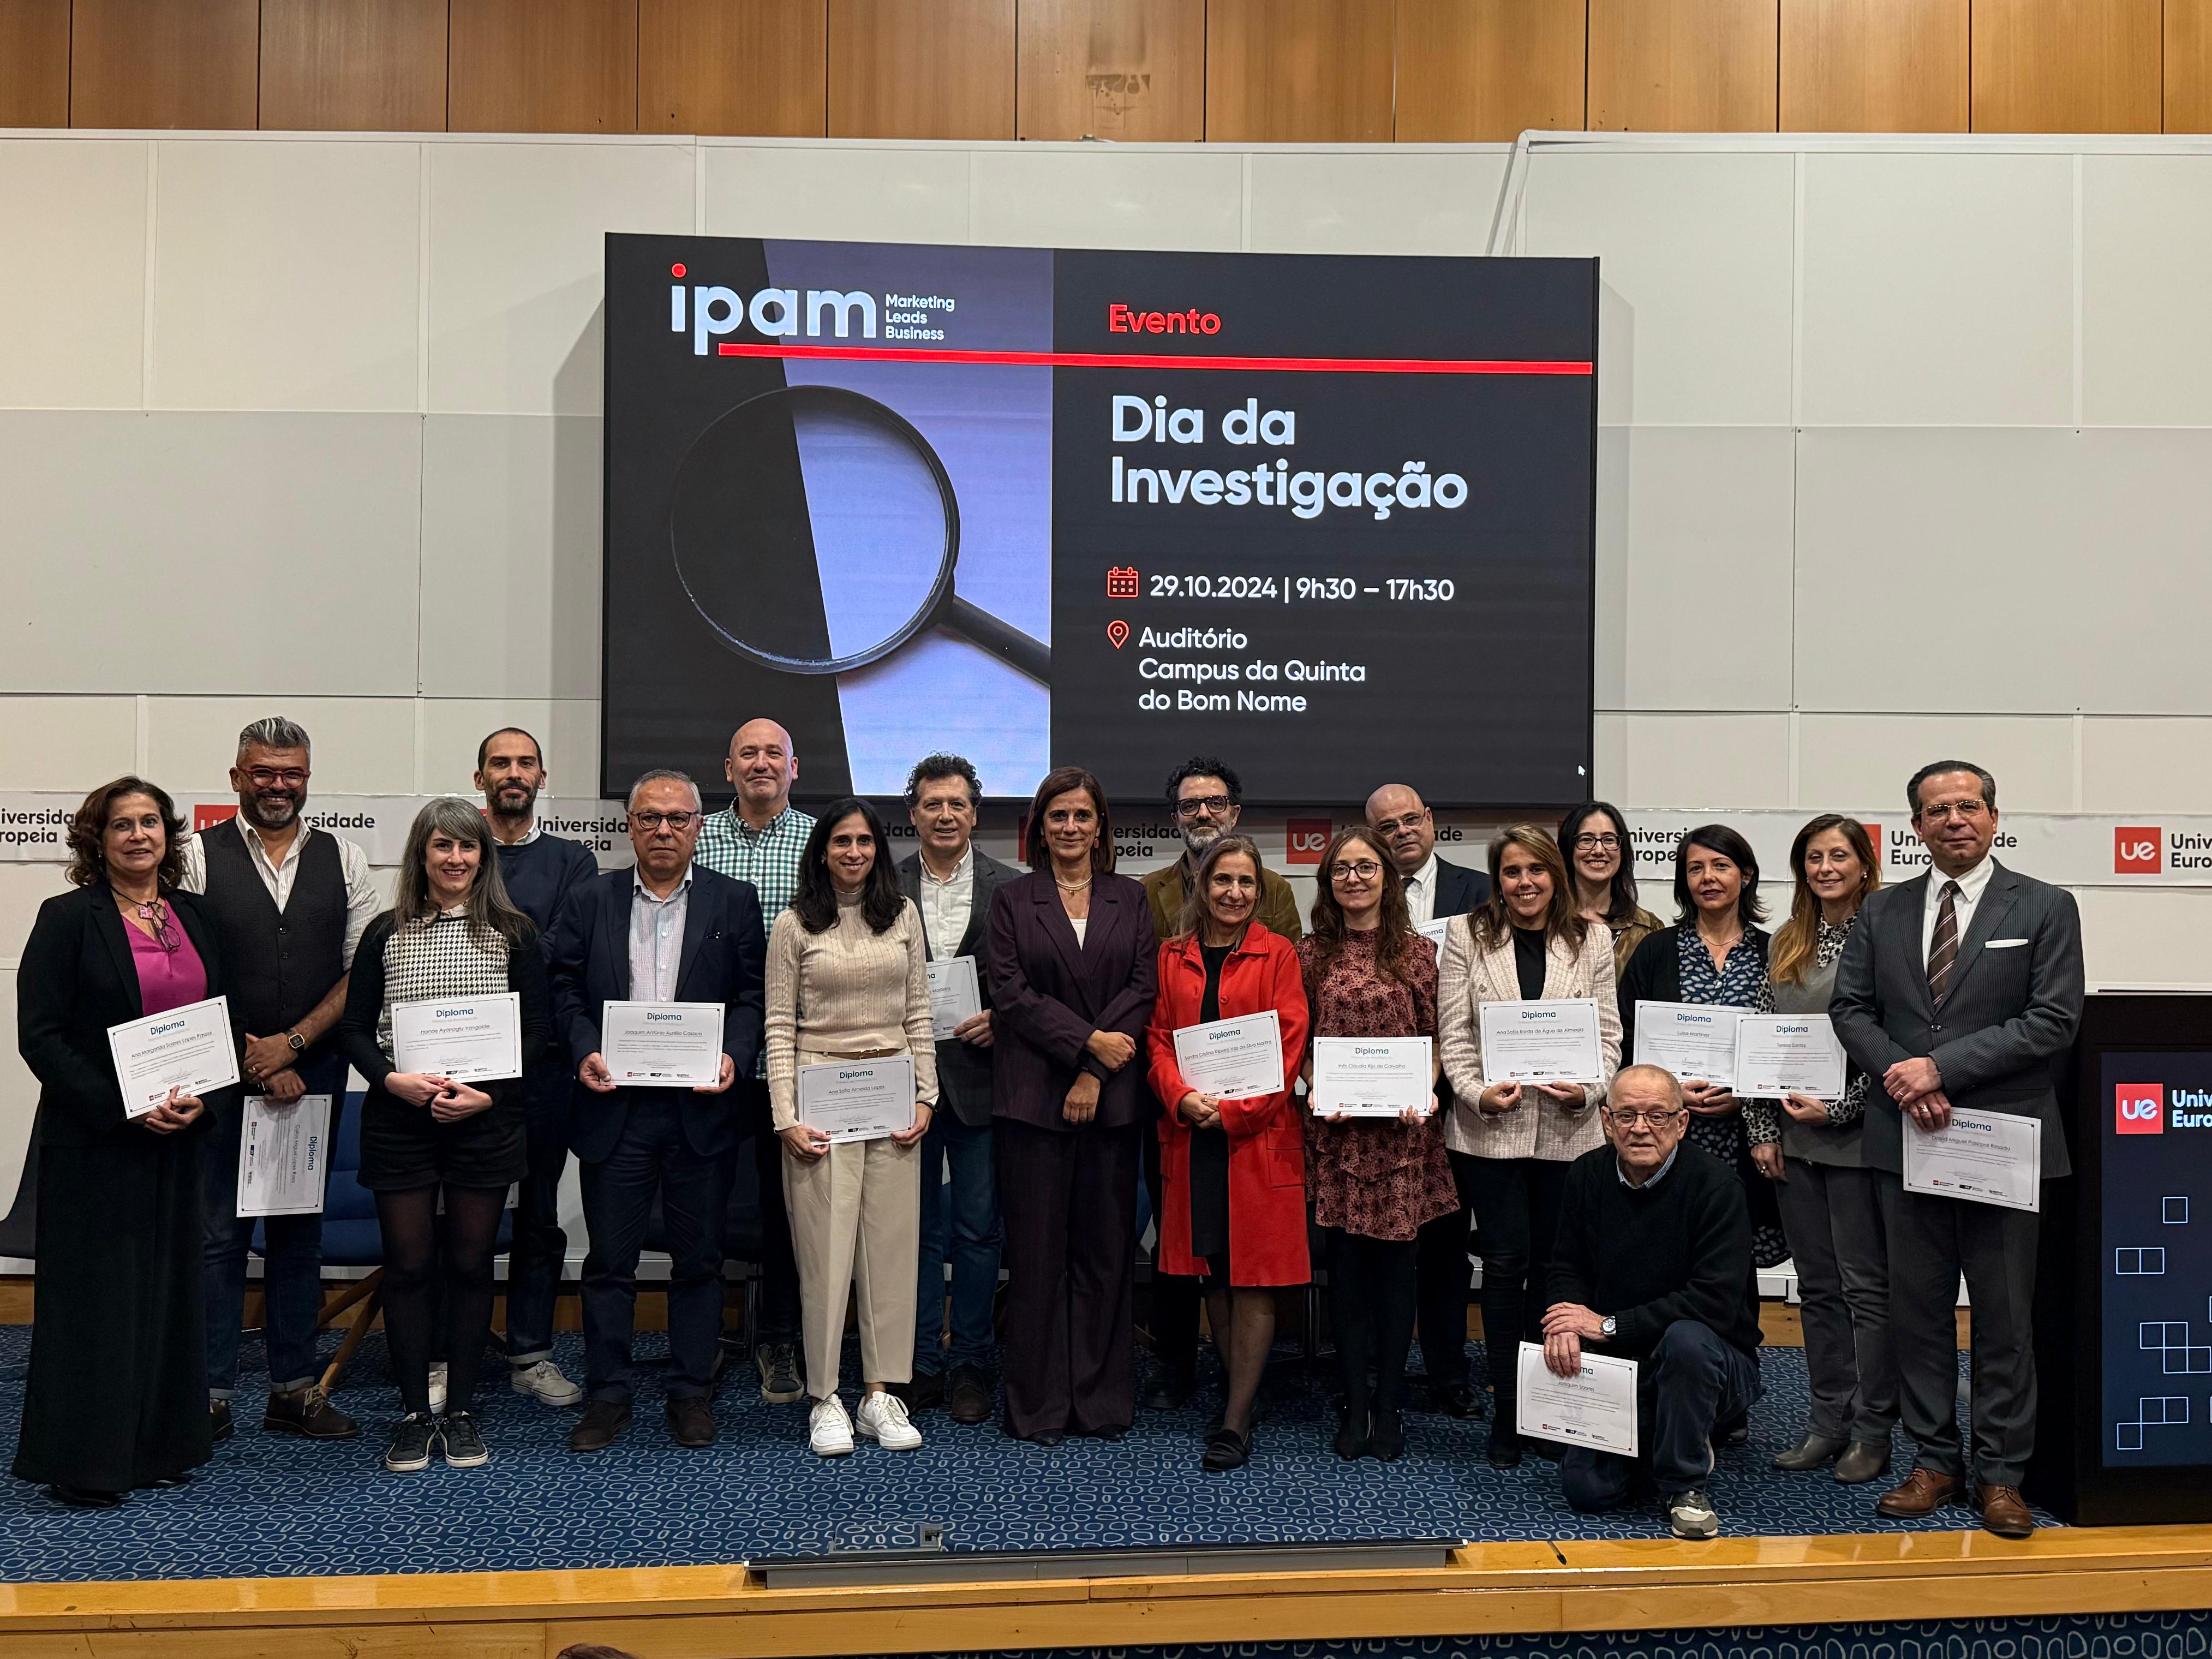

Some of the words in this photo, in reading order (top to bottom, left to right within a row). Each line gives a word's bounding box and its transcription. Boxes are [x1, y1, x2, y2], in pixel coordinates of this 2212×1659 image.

[672, 263, 877, 355] ipam
[886, 294, 955, 313] Marketing
[886, 310, 927, 325] Leads
[1109, 304, 1221, 335] Evento
[886, 326, 944, 341] Business
[1113, 395, 1203, 443] Dia
[1222, 398, 1295, 445] da
[1112, 456, 1468, 520] Investigação
[1150, 575, 1277, 599] 29.10.2024
[1296, 577, 1355, 600] 9h30
[1386, 579, 1455, 601] 17h30
[1139, 626, 1247, 649] Auditório
[1139, 658, 1239, 684] Campus
[1245, 660, 1277, 681] da
[1284, 660, 1365, 682] Quinta
[1139, 689, 1170, 711] do
[1178, 690, 1230, 711] Bom
[1237, 691, 1307, 712] Nome
[1293, 833, 1326, 851] ue
[2121, 842, 2156, 861] ue
[437, 1008, 474, 1018] Diploma
[647, 1012, 681, 1021] Diploma
[1522, 1011, 1556, 1019] Diploma
[1677, 1013, 1711, 1023] Diploma
[151, 1021, 184, 1035] Diploma
[1210, 1029, 1241, 1040] Diploma
[1776, 1025, 1808, 1034] Diploma
[1355, 1047, 1389, 1055] Diploma
[840, 1070, 873, 1079] Diploma
[2122, 1099, 2157, 1120] ue
[1952, 1119, 1992, 1131] Diploma
[308, 1136, 317, 1171] Diploma
